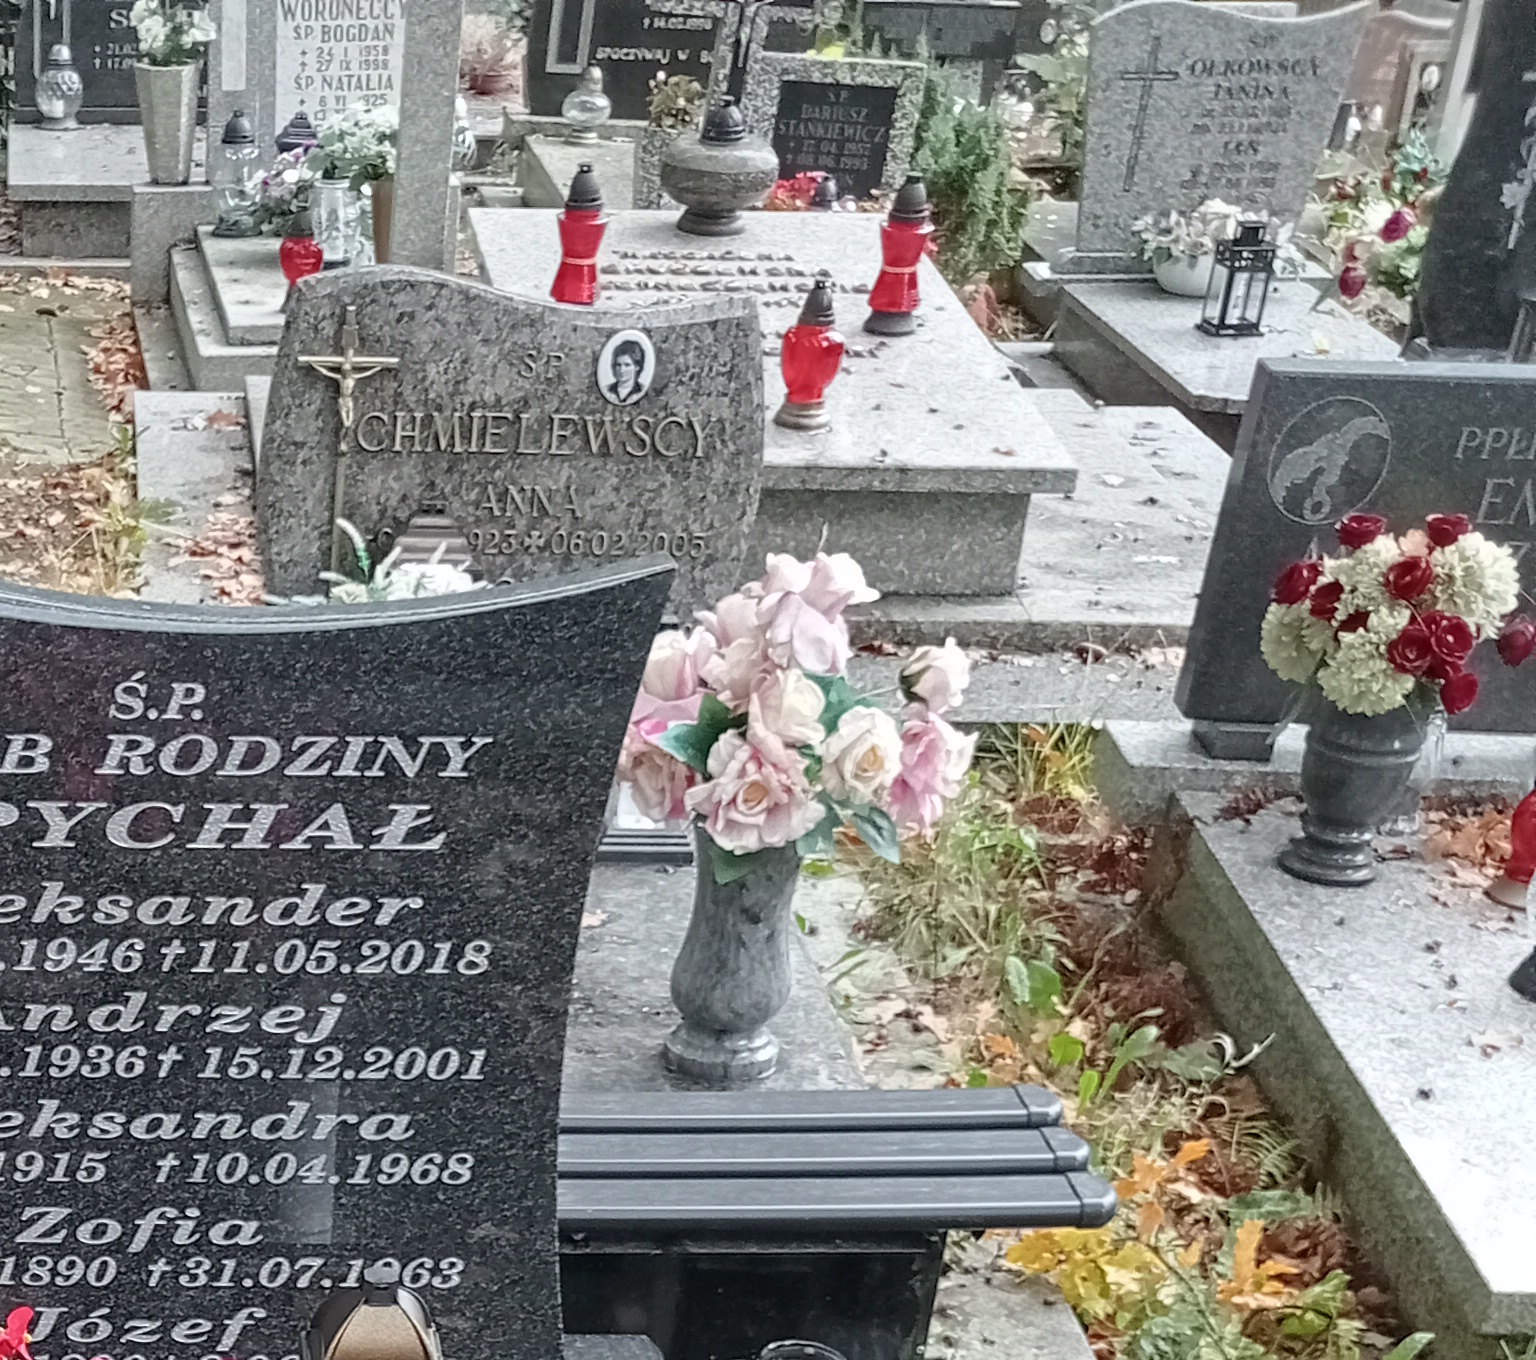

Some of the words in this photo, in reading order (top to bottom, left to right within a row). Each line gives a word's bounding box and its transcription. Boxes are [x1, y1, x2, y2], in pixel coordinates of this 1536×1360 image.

[320, 22, 396, 44] BOGDAN
[321, 73, 394, 93] NATALIA
[356, 409, 719, 459] CHMIELEWSCY
[480, 484, 583, 518] ANNA
[94, 733, 493, 779] RODZINY
[190, 938, 493, 976] 11.05.2018
[197, 1045, 488, 1082] 15.12.2001
[187, 1151, 476, 1186] 10.04.1968
[15, 1205, 265, 1254] Zofia
[28, 1307, 268, 1352] Józef
